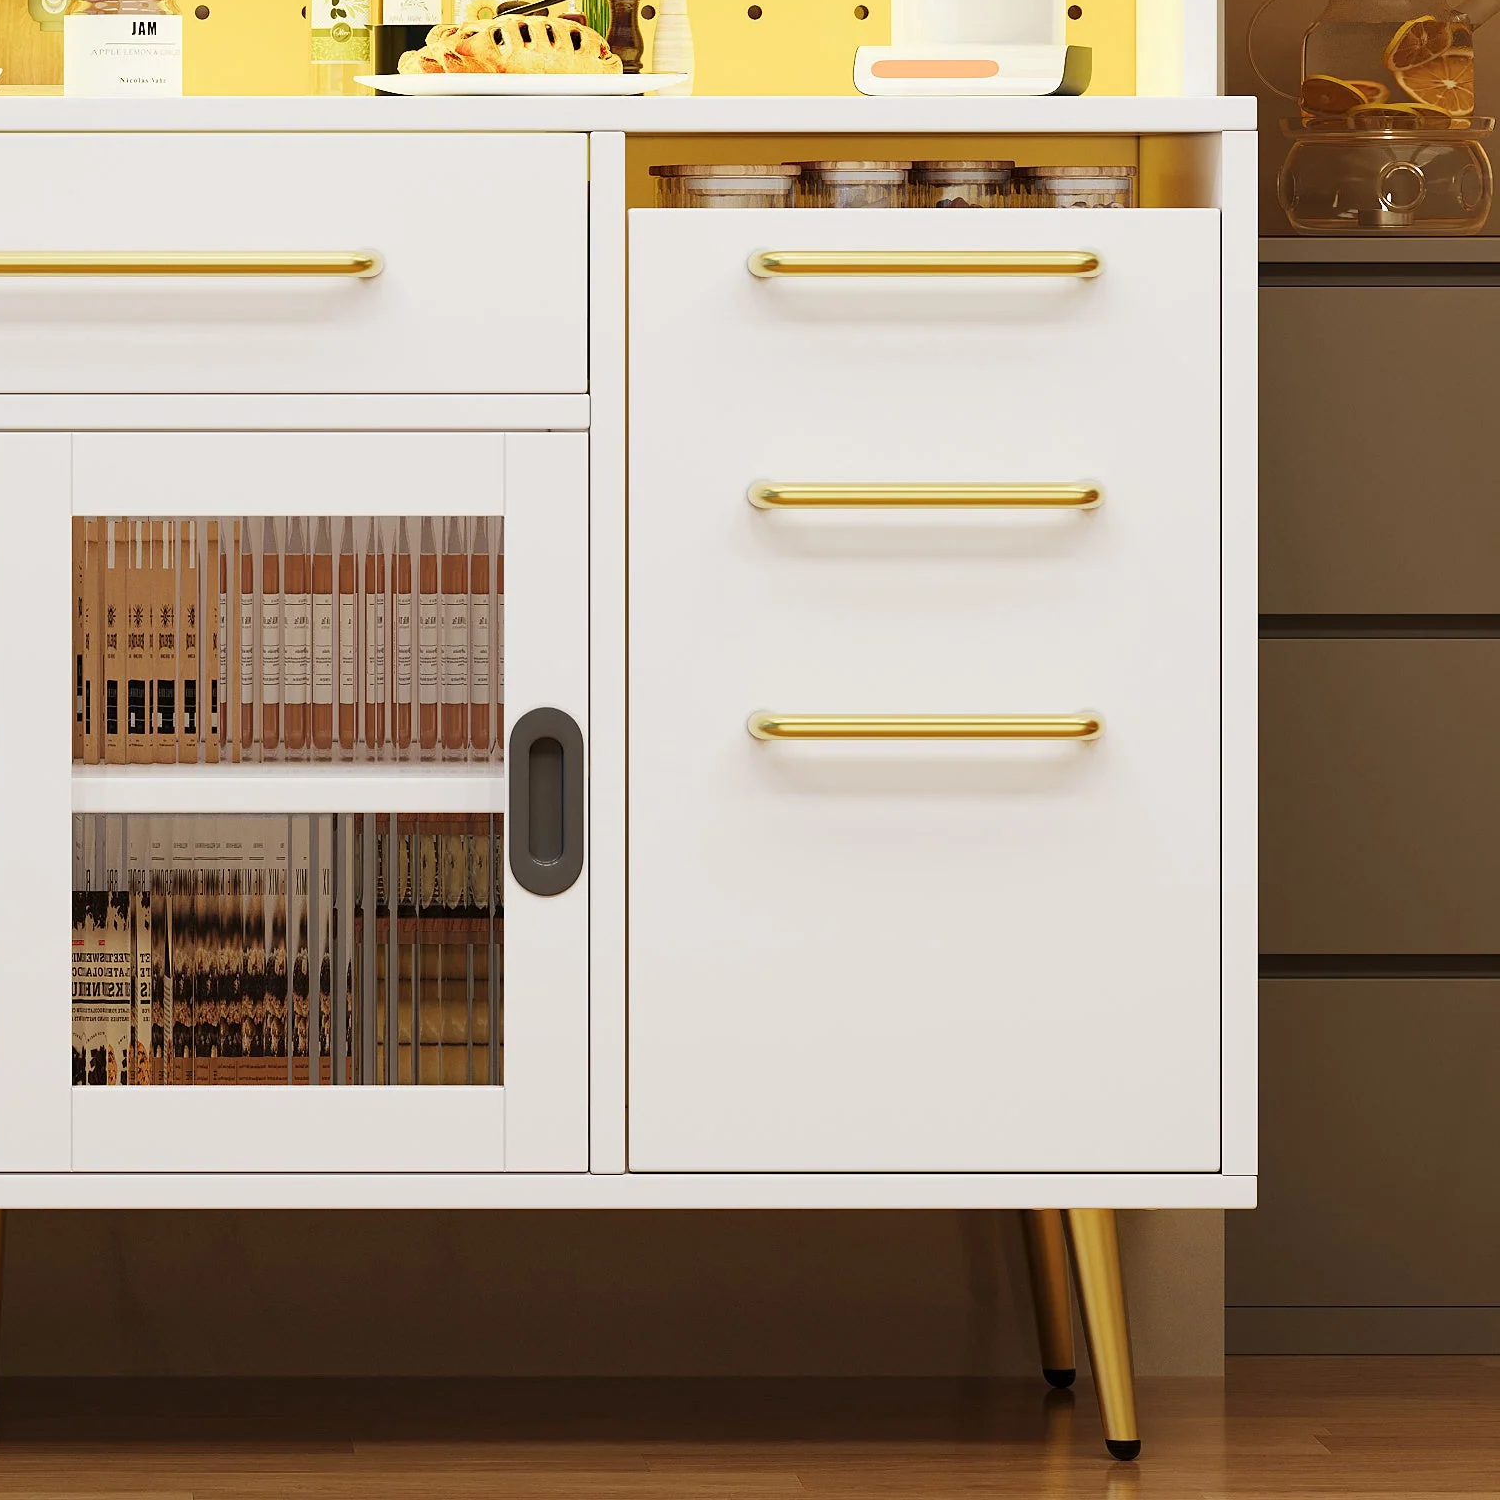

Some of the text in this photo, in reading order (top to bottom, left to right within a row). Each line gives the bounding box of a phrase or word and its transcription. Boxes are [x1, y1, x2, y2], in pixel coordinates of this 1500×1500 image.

[131, 21, 157, 36] JAM
[91, 48, 120, 56] APPLE
[123, 48, 151, 56] LEMON
